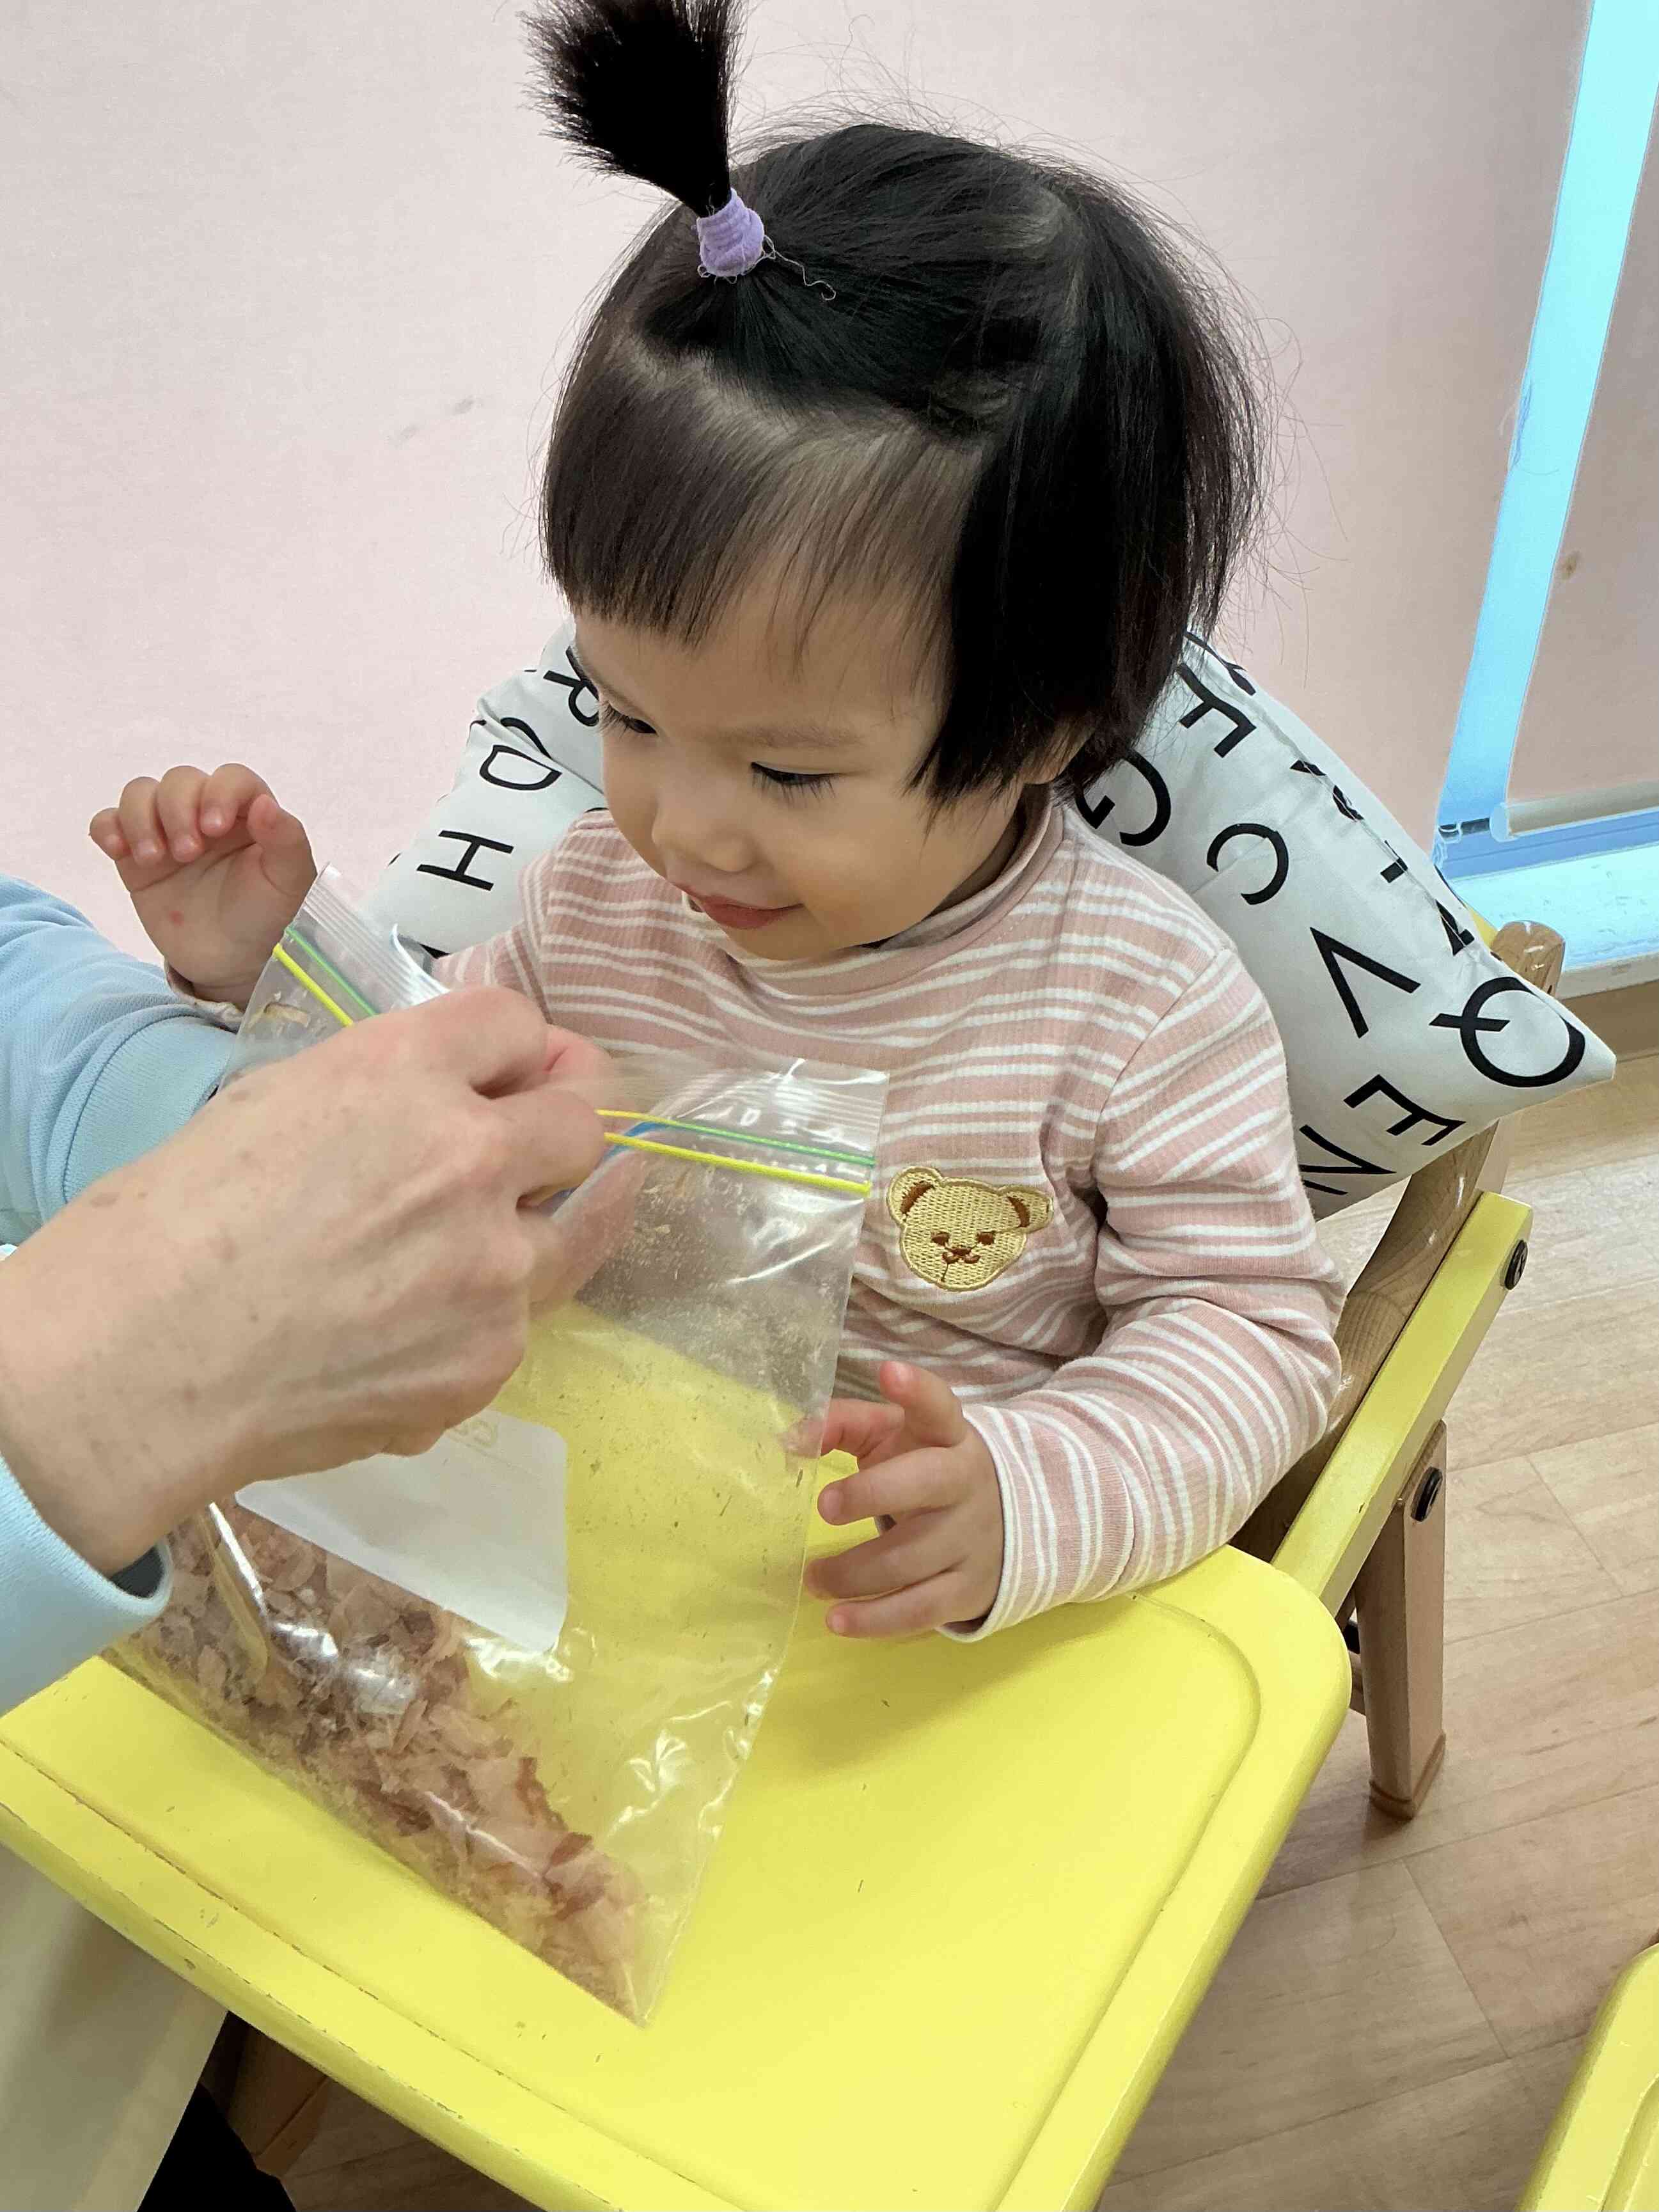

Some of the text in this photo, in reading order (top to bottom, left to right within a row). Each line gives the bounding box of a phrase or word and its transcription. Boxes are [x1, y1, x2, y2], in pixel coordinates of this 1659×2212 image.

[416, 830, 514, 891] H
[1207, 823, 1289, 905] C
[1310, 927, 1421, 1039] V
[1429, 977, 1585, 1088] Q
[1343, 1074, 1466, 1146] E
